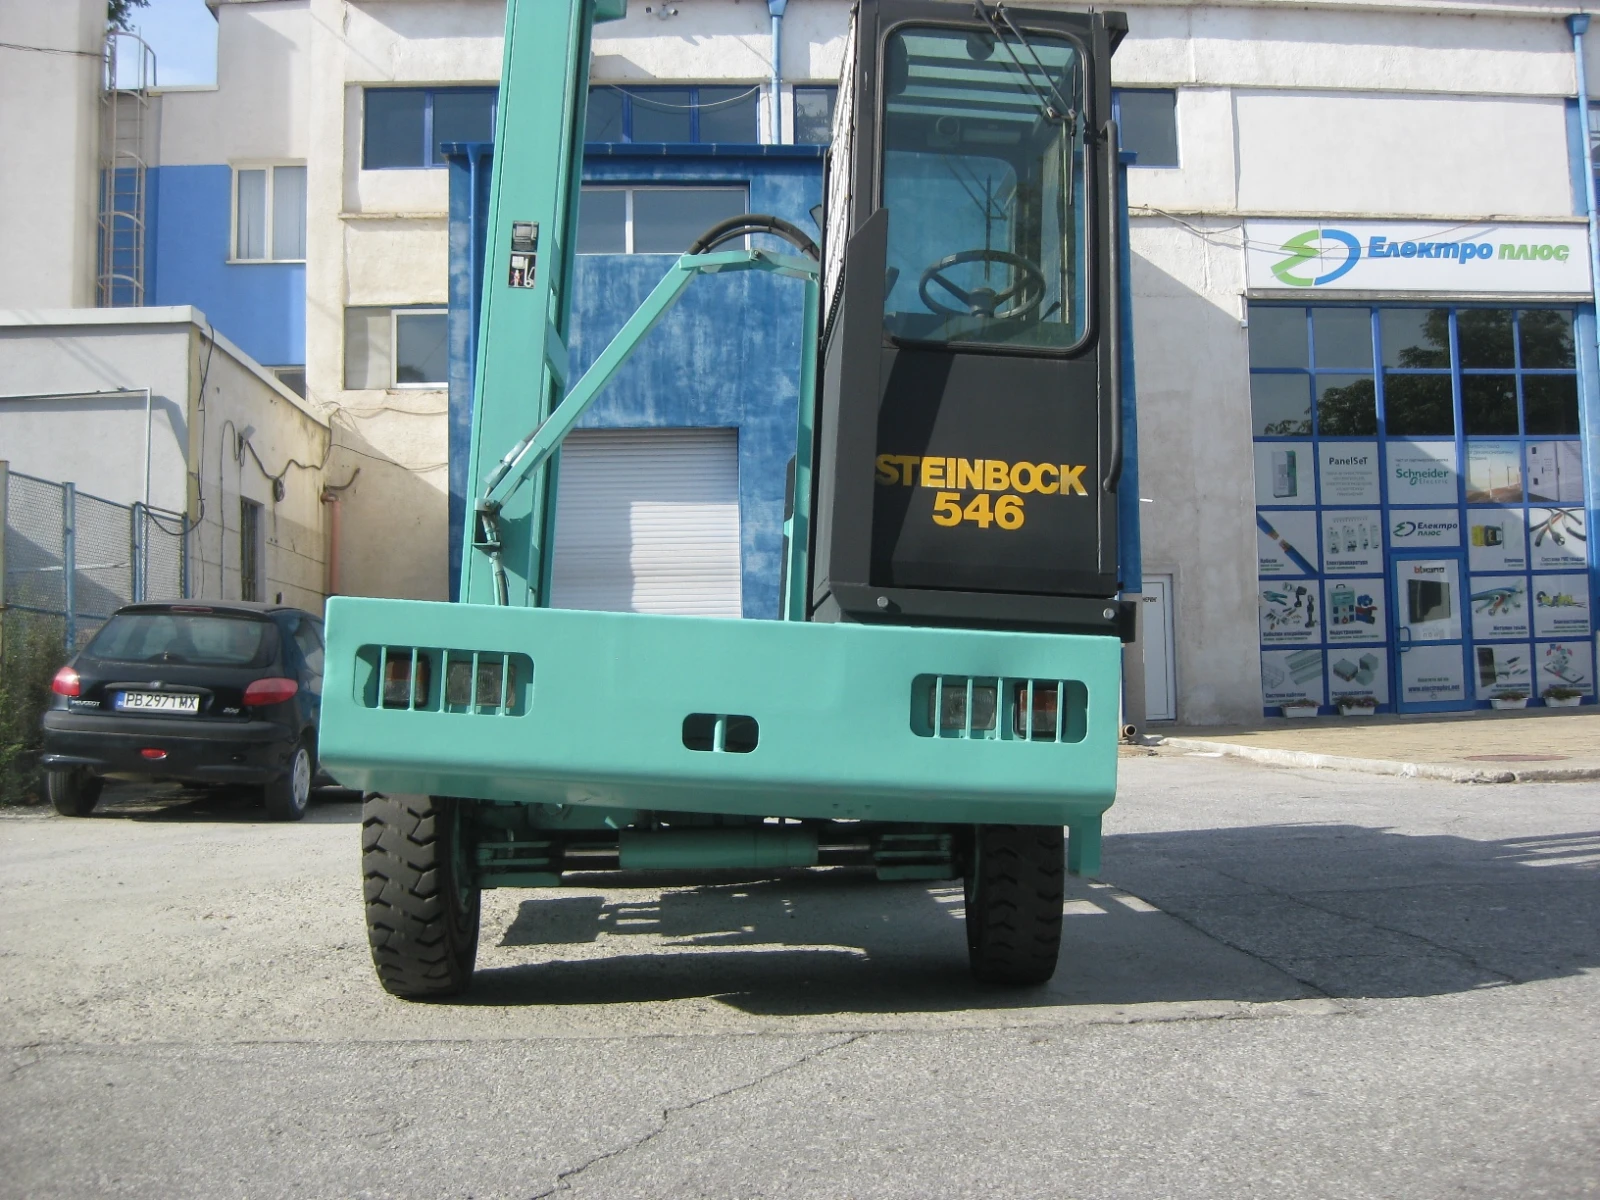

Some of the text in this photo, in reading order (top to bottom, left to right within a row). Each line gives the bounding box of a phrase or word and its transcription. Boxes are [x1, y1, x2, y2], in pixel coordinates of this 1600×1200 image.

[1368, 236, 1569, 264] Електро плюс
[1329, 456, 1368, 465] PanelSeT
[875, 454, 1088, 496] STEINBOCK
[1395, 468, 1448, 479] Schneider
[932, 491, 1024, 530] 546
[1417, 521, 1458, 531] Електро
[126, 692, 143, 706] PB
[146, 694, 176, 708] 2971
[178, 696, 196, 710] MX
